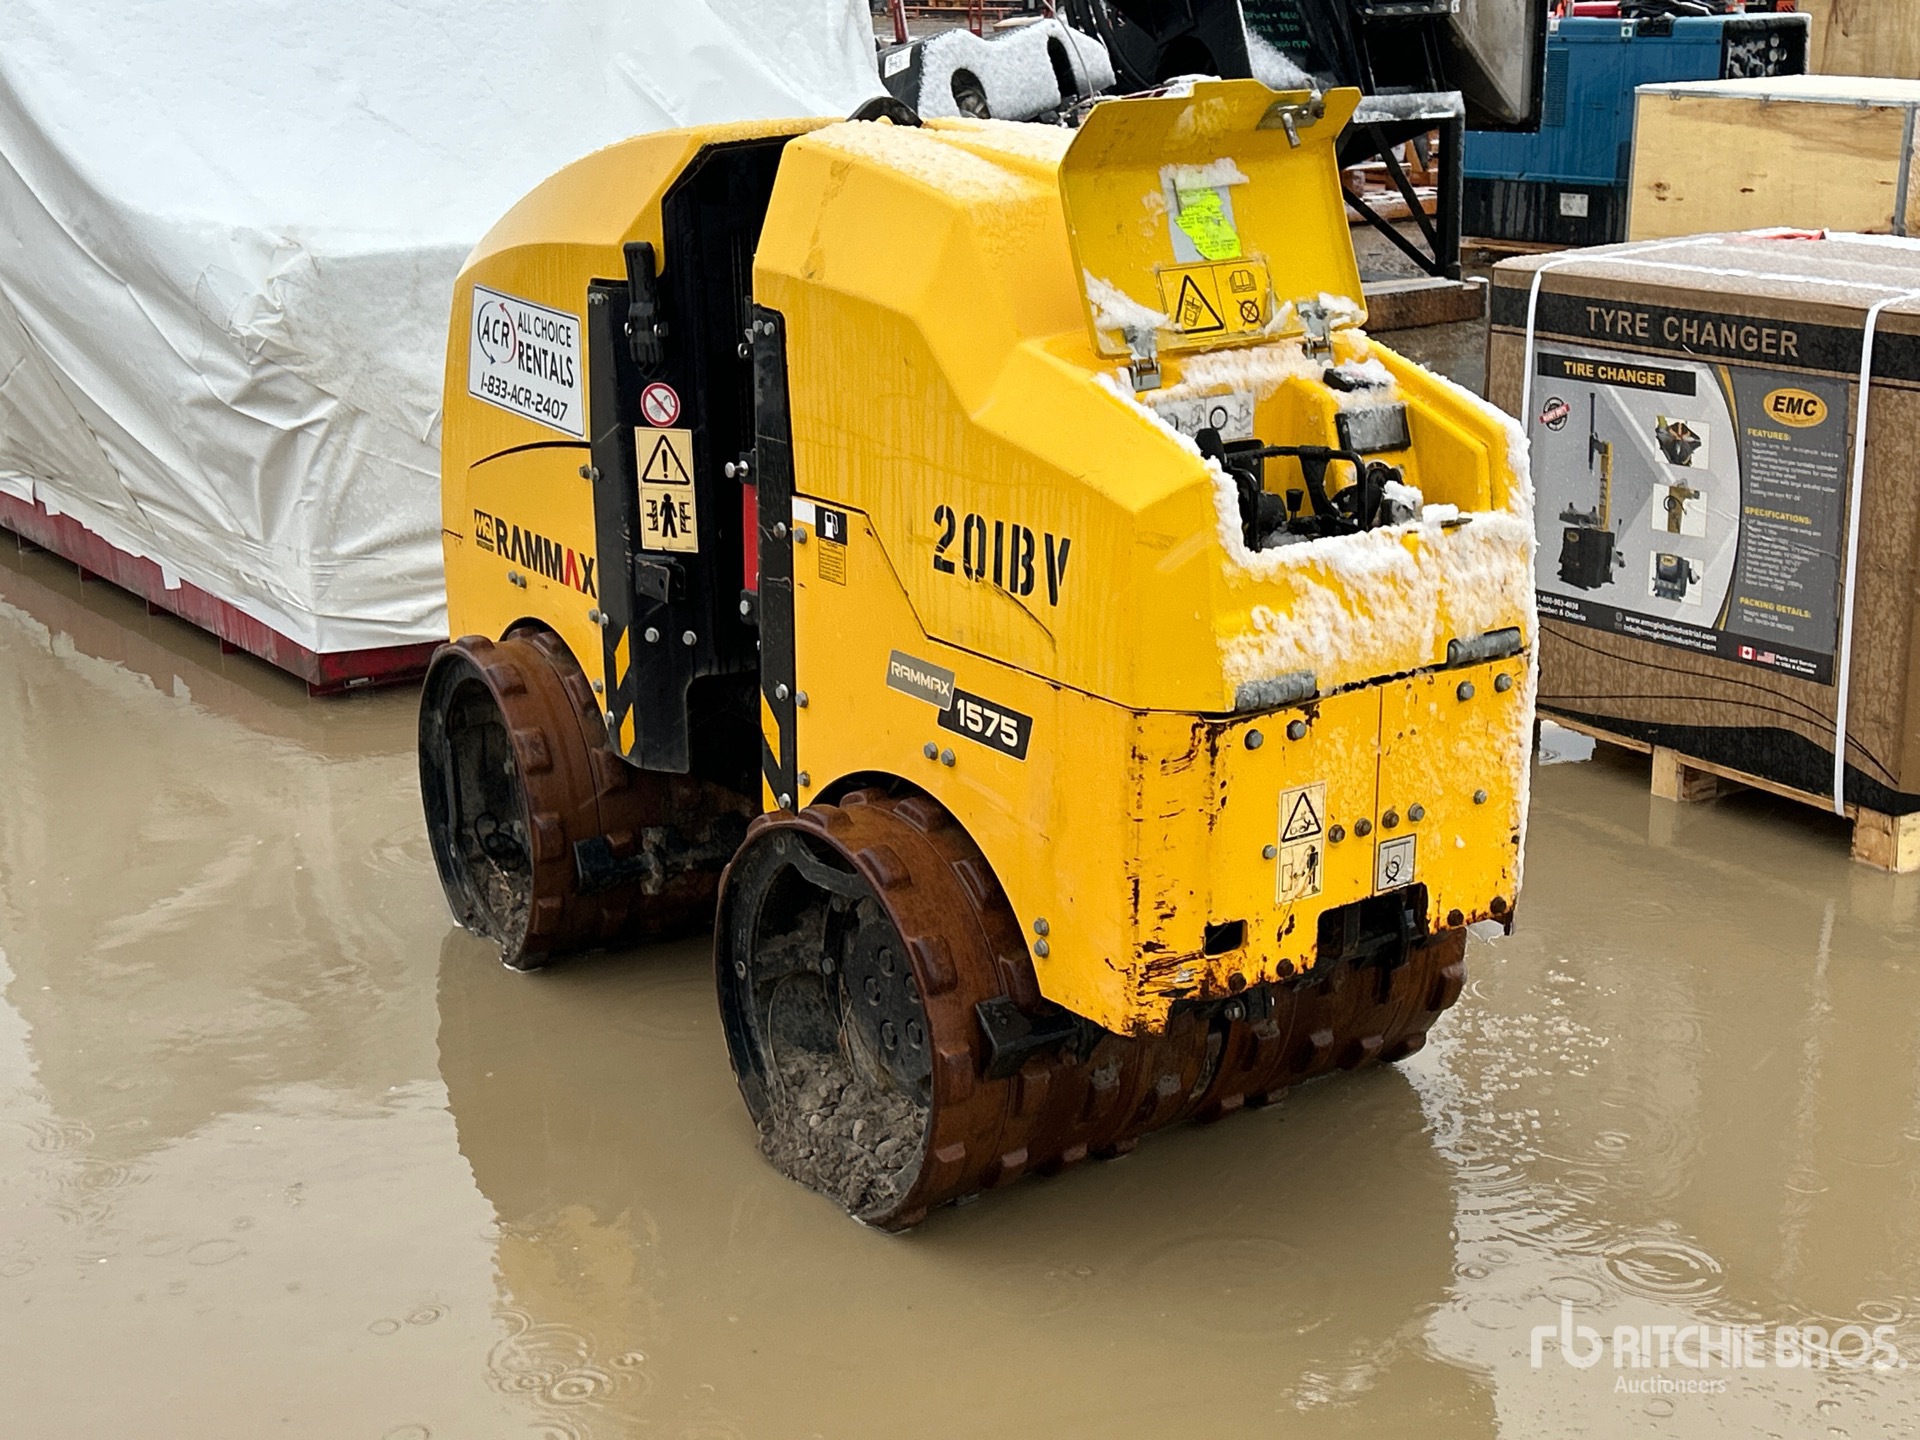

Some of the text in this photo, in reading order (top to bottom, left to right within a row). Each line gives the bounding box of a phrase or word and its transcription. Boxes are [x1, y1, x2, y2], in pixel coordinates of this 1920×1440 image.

[481, 316, 510, 349] ACR
[517, 311, 572, 348] ALL CHOICE
[1586, 306, 1799, 358] TYRE CHANGER
[518, 340, 574, 389] RENTALS
[1563, 361, 1666, 387] TIRE CHANGER
[481, 371, 568, 422] 1-833-ACR-2407
[1772, 395, 1818, 416] EMC
[1747, 427, 1792, 441] FEATURES:
[1744, 506, 1812, 525] SPECIFICATIONS:
[495, 517, 597, 600] RAMMAX
[1739, 597, 1775, 611] PACKING
[1776, 604, 1812, 619] DETAILS:
[890, 661, 950, 697] RAMMAX
[956, 699, 1018, 748] 1575
